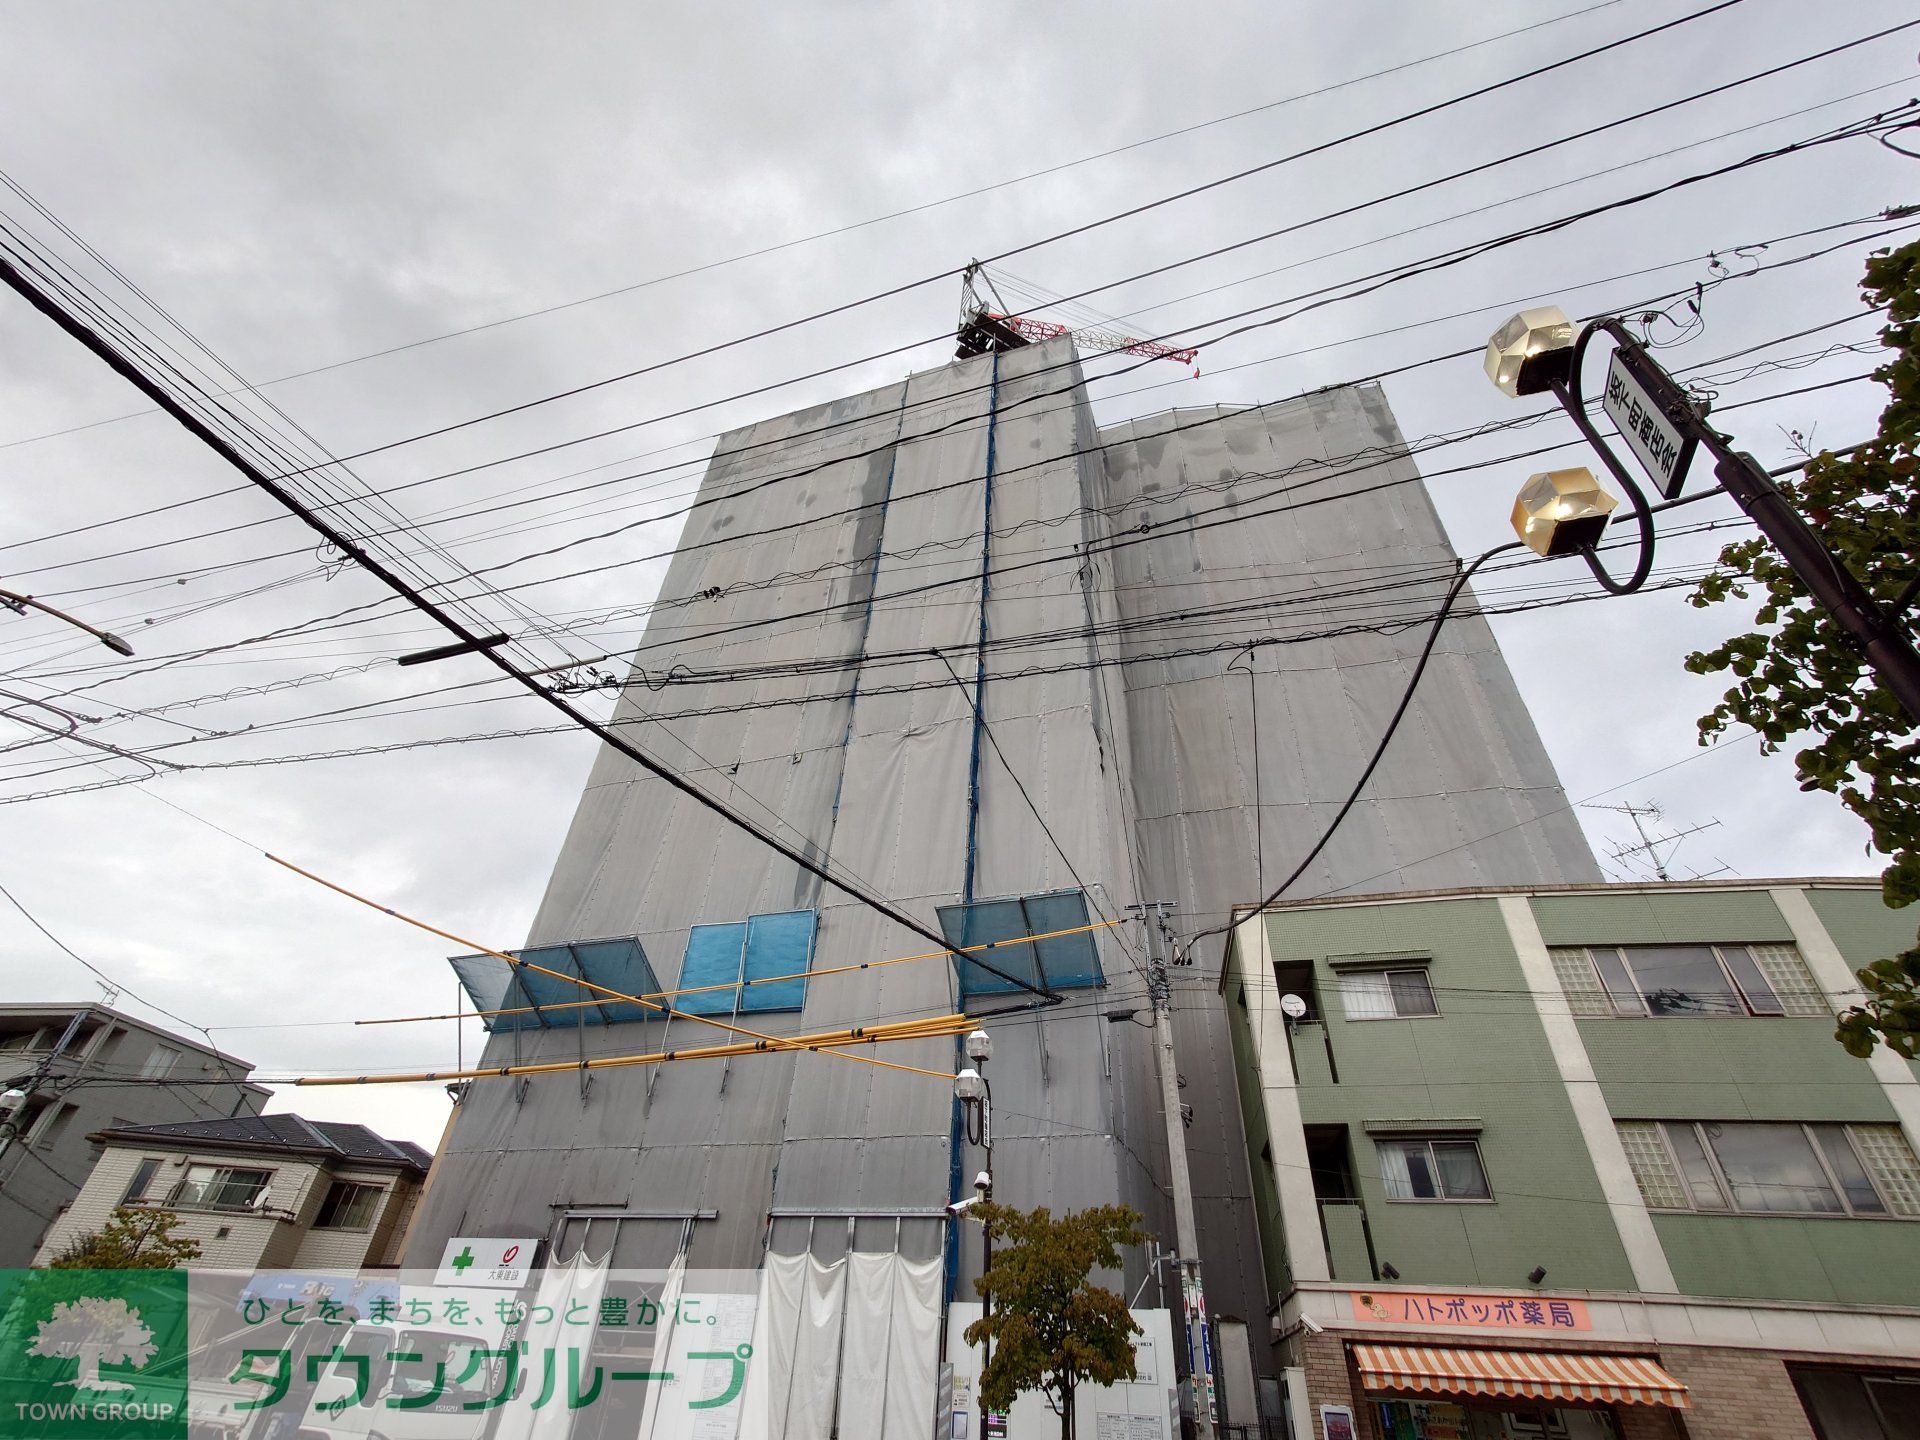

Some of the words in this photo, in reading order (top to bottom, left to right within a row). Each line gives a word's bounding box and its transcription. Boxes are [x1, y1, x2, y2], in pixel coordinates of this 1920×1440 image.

[1608, 371, 1677, 478] 坂下町商店会
[488, 1270, 519, 1280] 大東建設
[1404, 1298, 1575, 1327] ハトポッポ薬局
